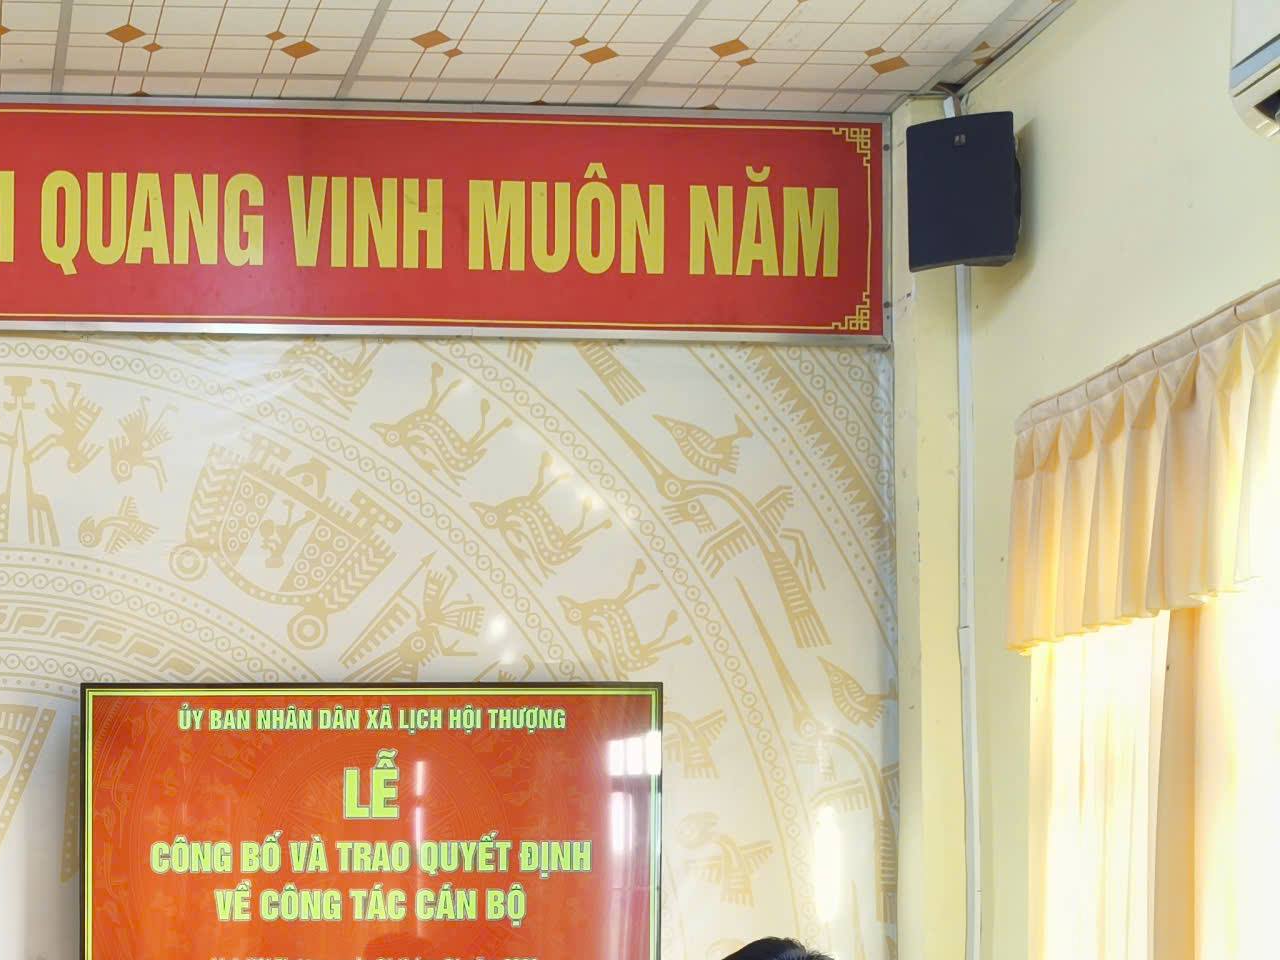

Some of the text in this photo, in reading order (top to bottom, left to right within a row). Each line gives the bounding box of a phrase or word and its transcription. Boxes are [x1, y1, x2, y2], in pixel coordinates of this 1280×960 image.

[41, 169, 264, 275] QUANG
[289, 174, 442, 270] VINH
[468, 161, 665, 275] MUÔN
[689, 165, 839, 279] NĂM
[177, 703, 567, 735] ỦY BAN NHÂN DÂN XÃ LỊCH HỘI THƯỢNG
[343, 748, 400, 820] LỄ
[150, 830, 592, 879] CÔNG BỐ VÀ TRAO QUYẾT ĐỊNH
[213, 879, 527, 928] VỀ CÔNG TÁC CÁN BỘ
